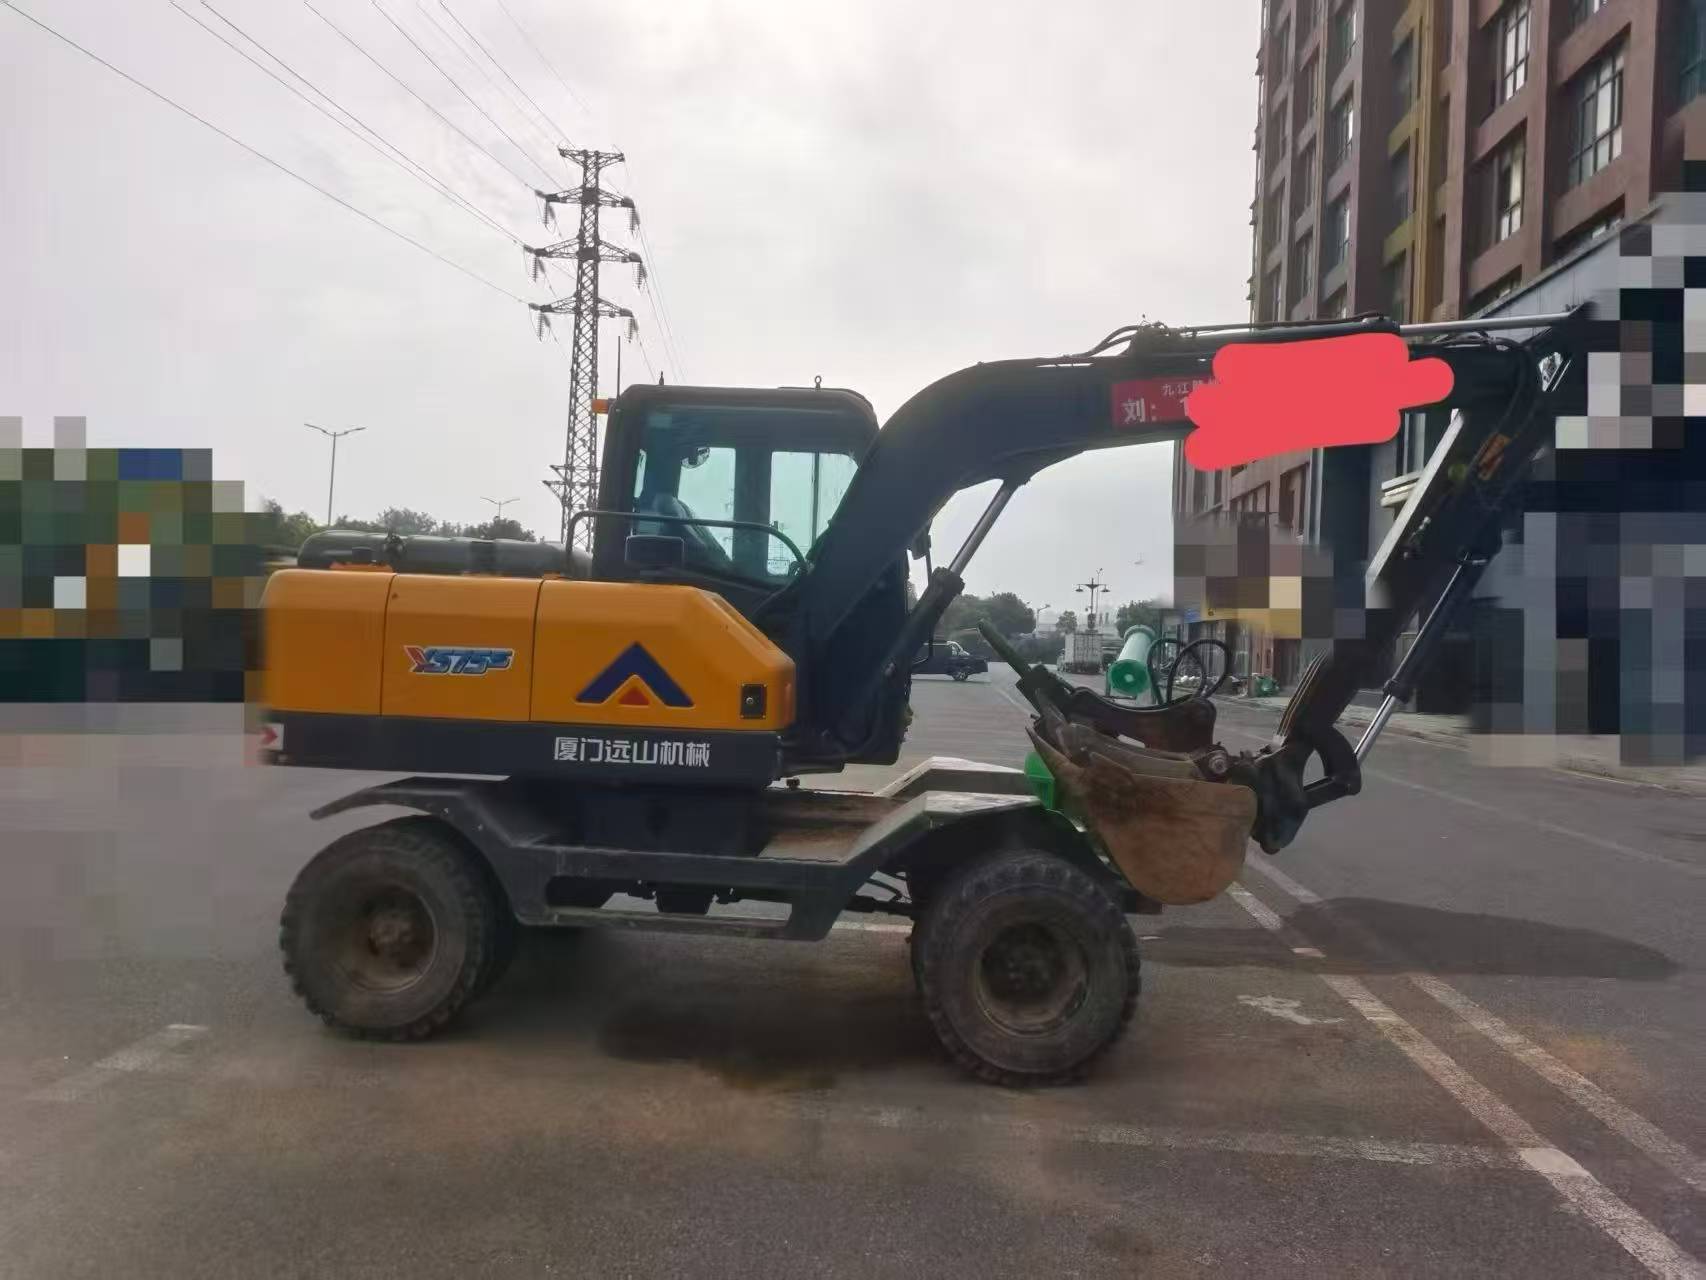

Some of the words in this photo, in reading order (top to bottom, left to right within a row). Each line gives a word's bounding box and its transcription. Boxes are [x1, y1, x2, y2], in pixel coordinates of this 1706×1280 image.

[553, 736, 712, 768] 厦门远山机械
